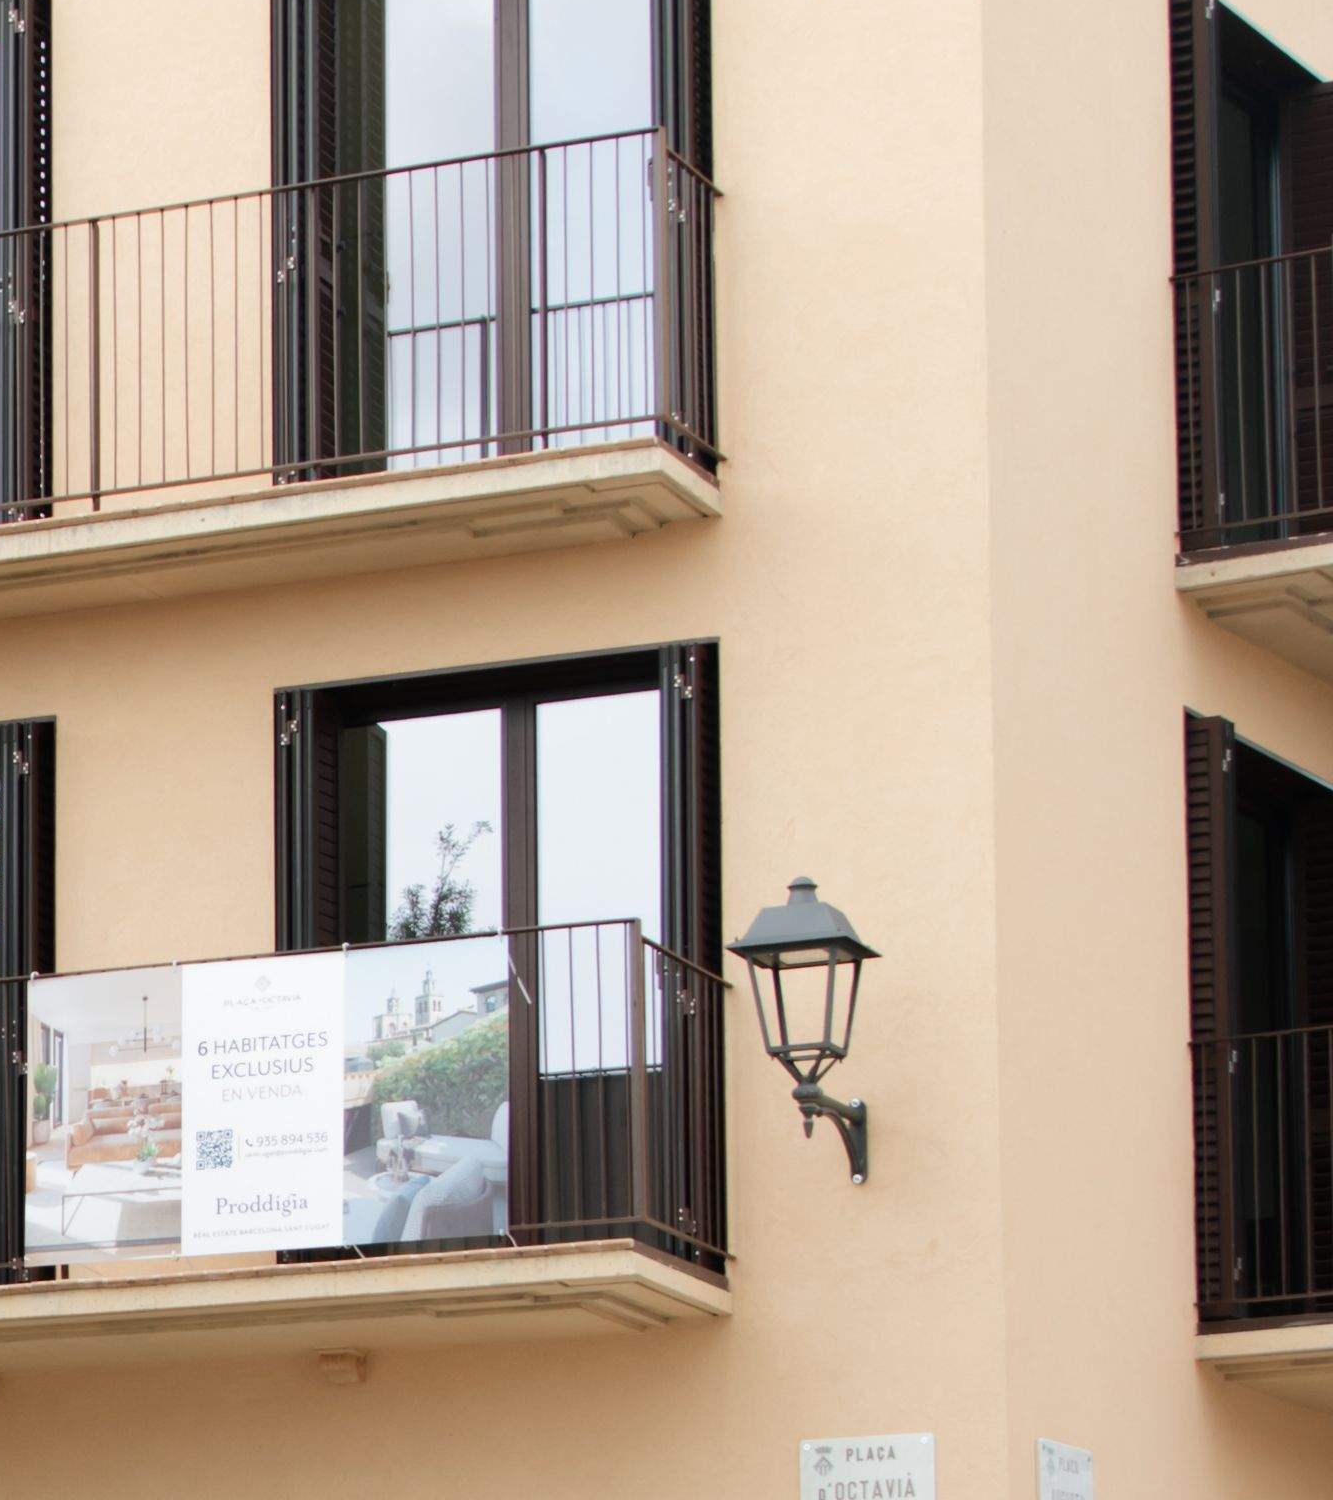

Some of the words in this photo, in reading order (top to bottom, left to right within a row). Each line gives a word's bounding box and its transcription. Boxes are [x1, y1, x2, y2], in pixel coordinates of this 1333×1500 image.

[198, 1041, 208, 1057] 6
[214, 1031, 329, 1054] HABITATGES
[211, 1056, 314, 1080] EXCLUSIUS
[222, 1088, 242, 1102] EN
[247, 1084, 304, 1100] VENDA
[845, 1445, 897, 1462] PLAÇA
